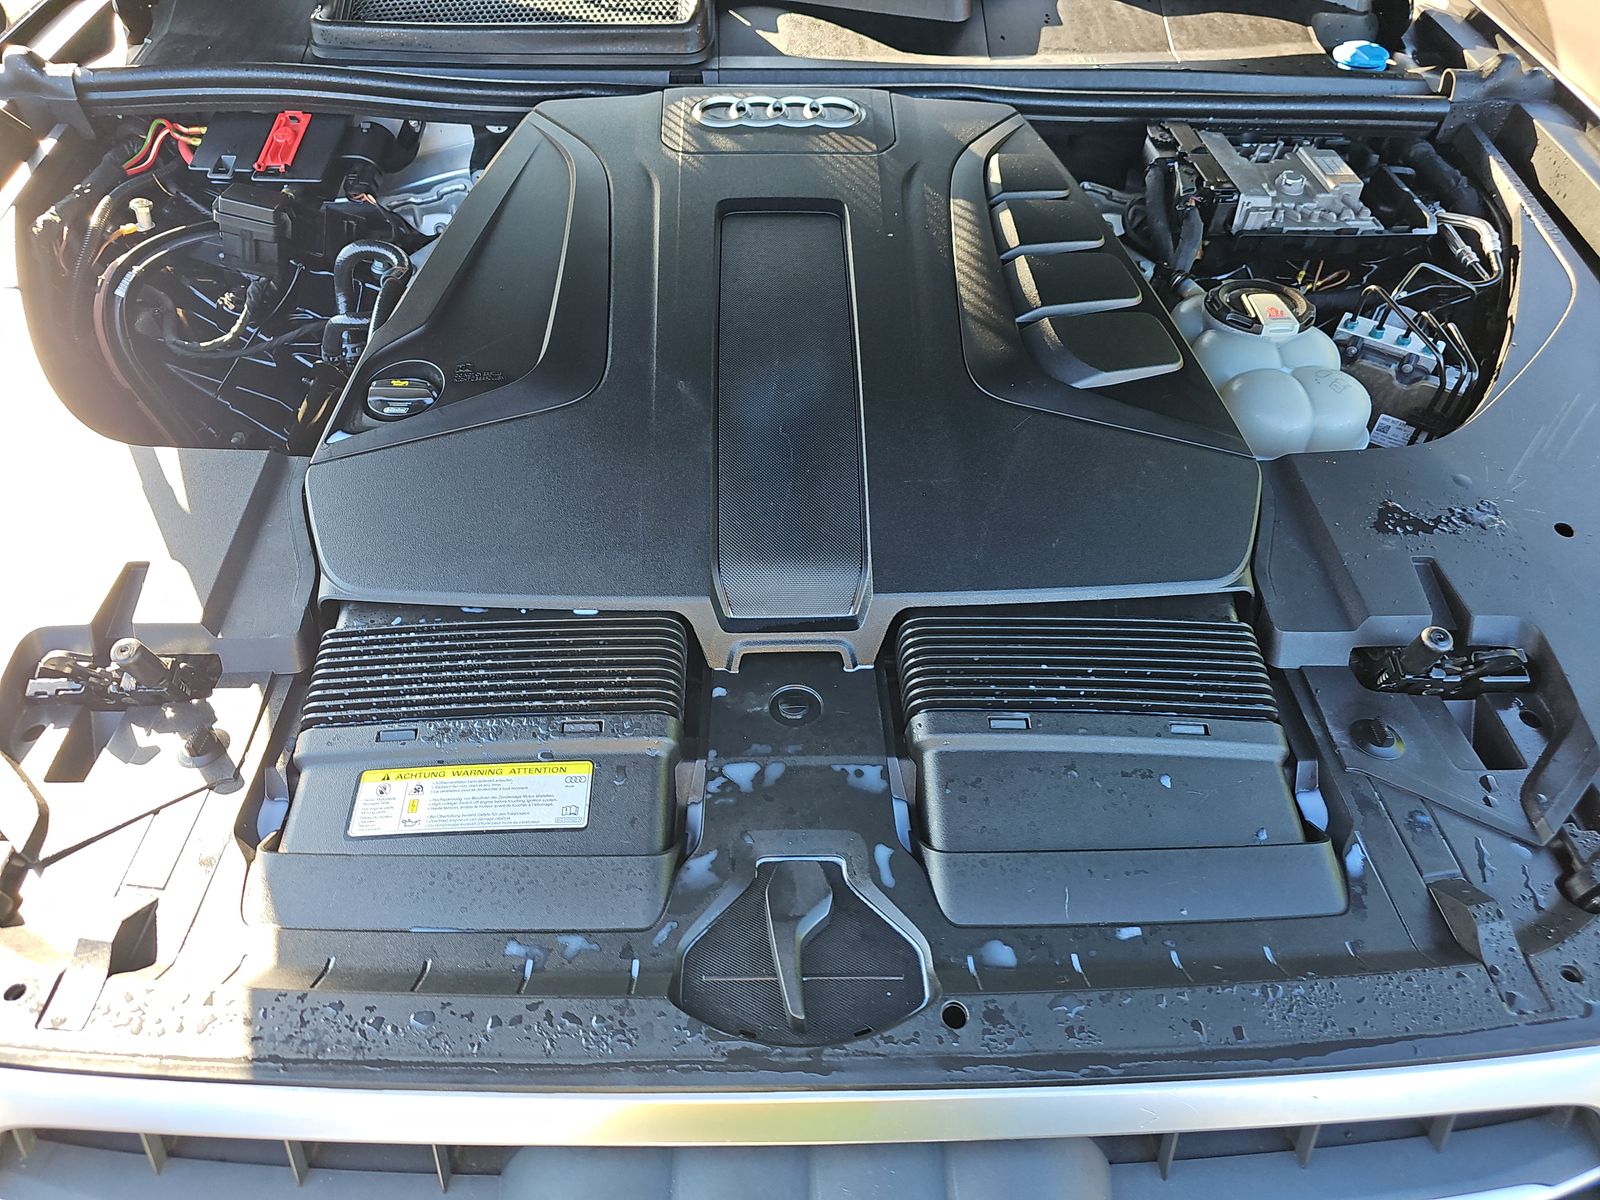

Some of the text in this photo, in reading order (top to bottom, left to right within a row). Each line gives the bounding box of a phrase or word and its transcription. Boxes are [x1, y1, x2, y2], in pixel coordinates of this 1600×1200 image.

[395, 766, 567, 781] ACHTUNG WARNING ATTENTION
